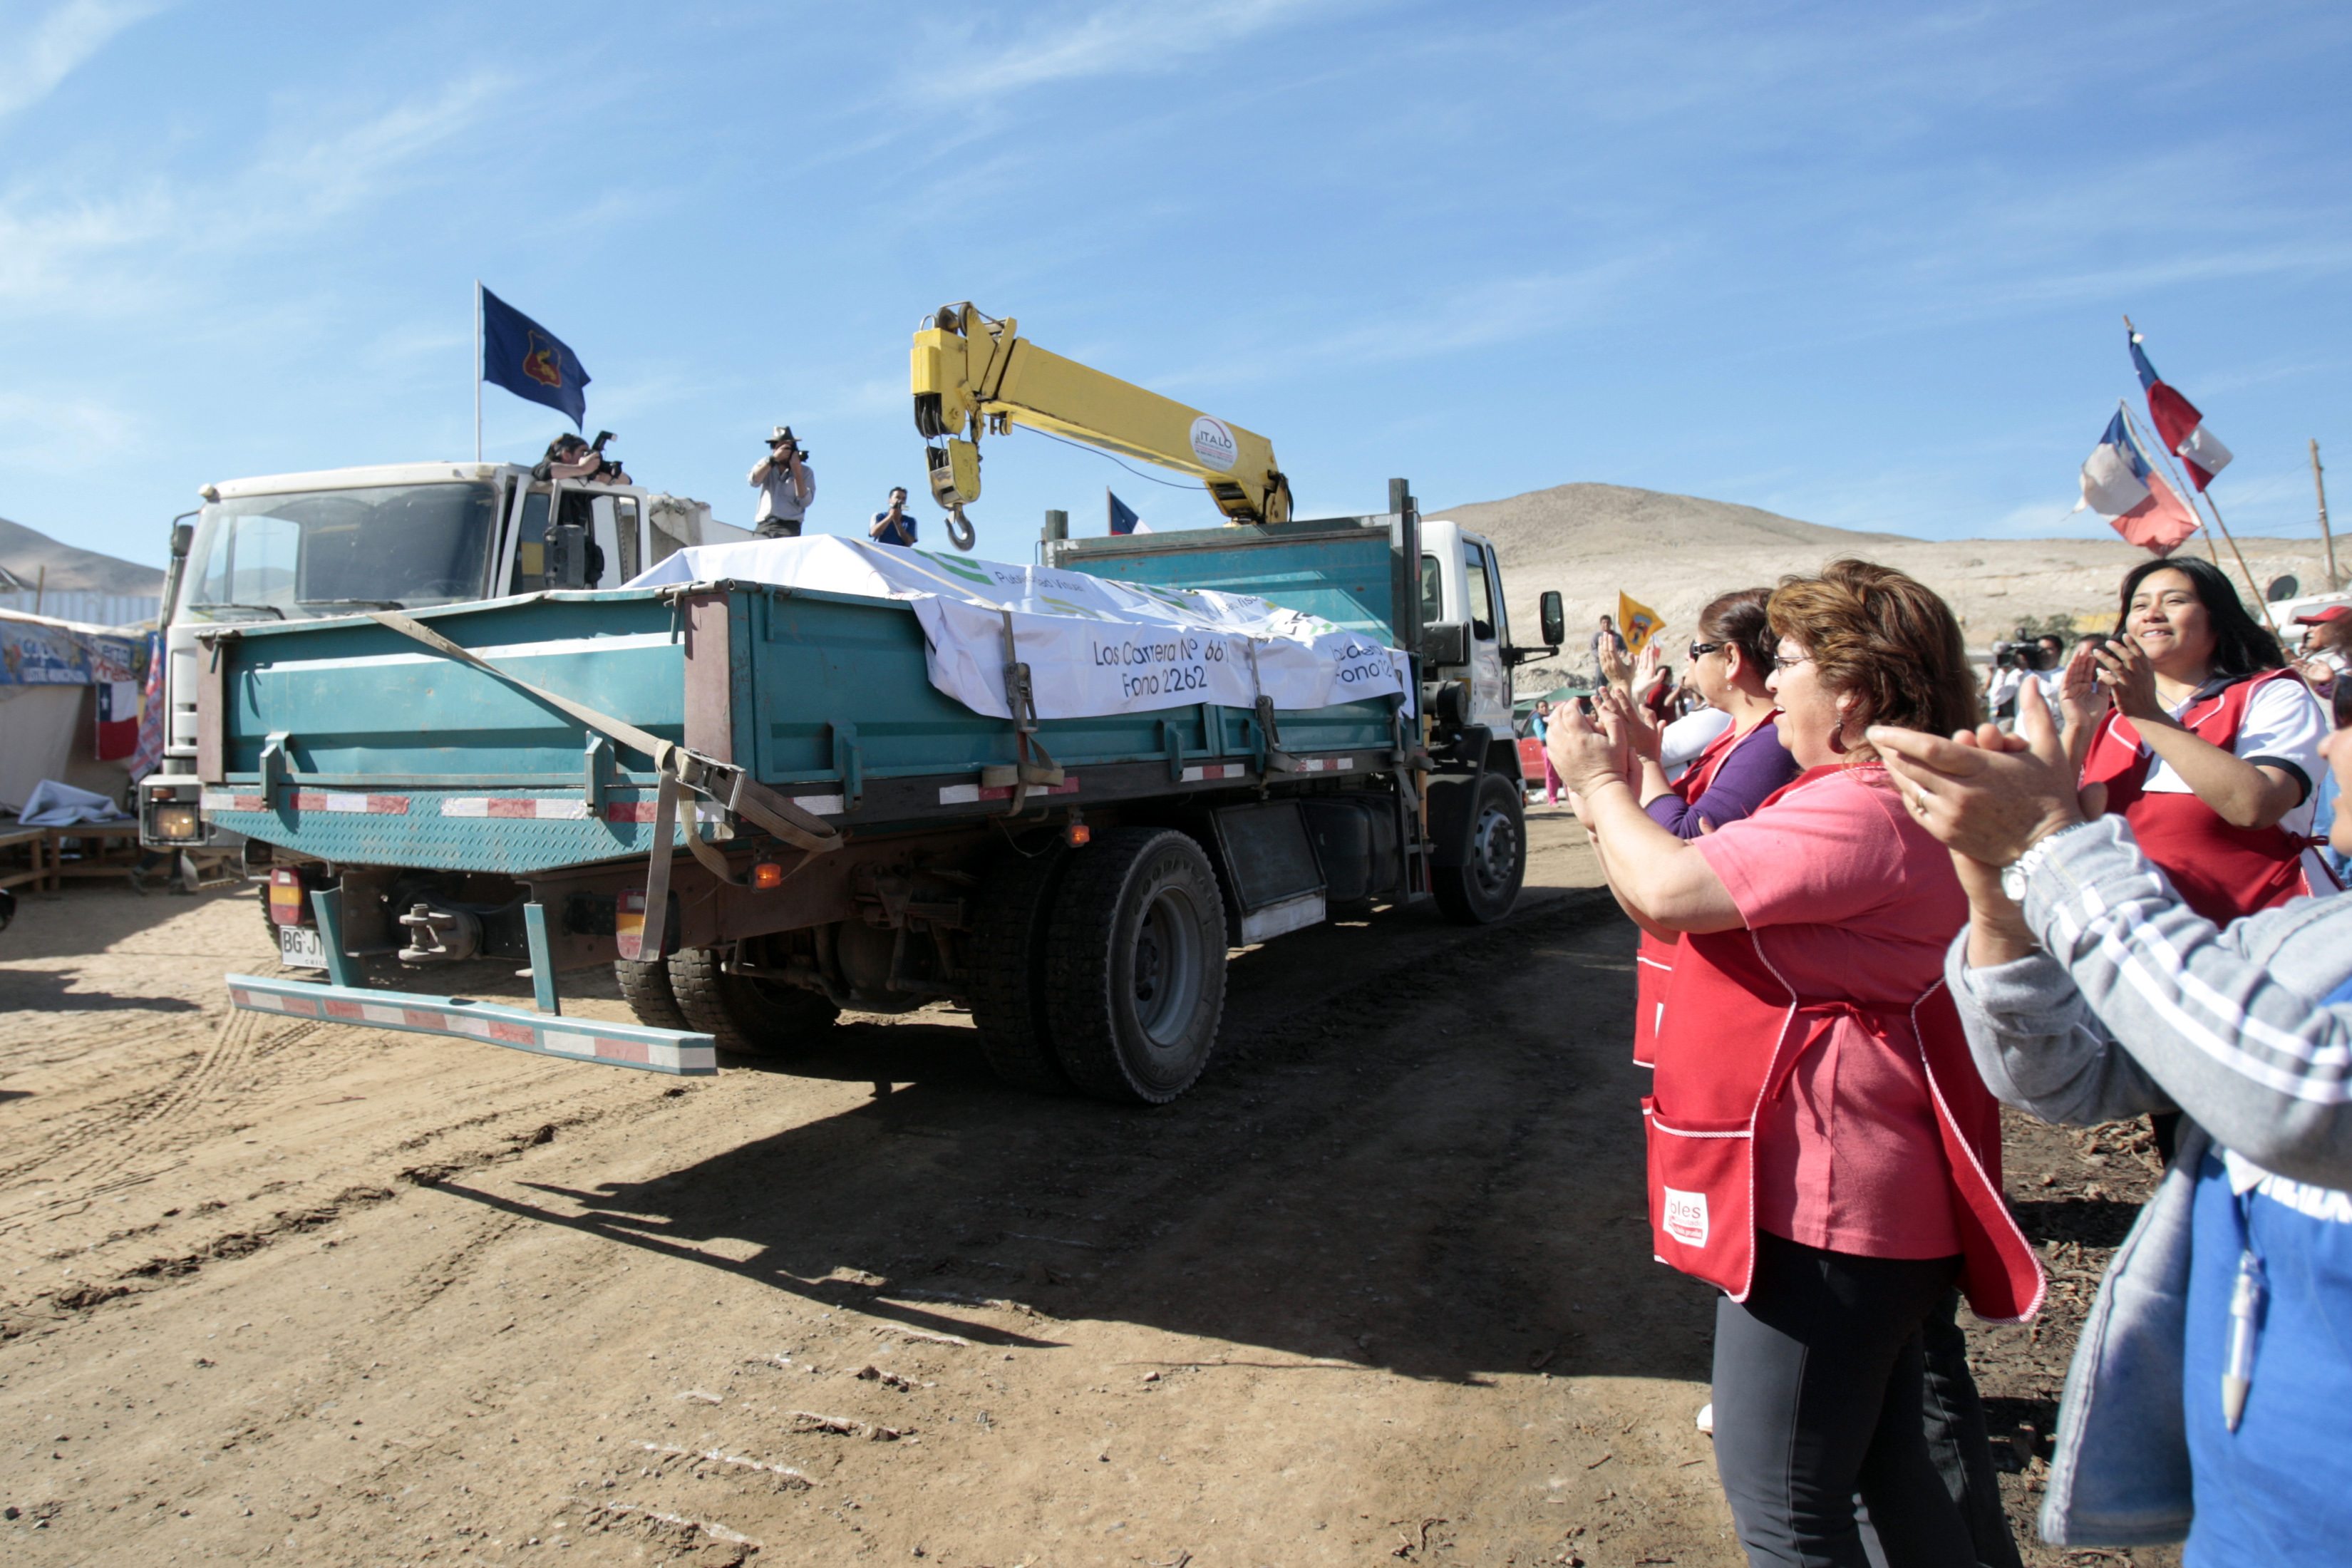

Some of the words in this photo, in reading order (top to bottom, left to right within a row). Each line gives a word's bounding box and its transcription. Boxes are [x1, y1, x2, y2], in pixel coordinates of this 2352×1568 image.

[1200, 430, 1232, 449] ITALO
[1093, 640, 1119, 666] Los
[1123, 641, 1176, 666] Carrera
[1122, 673, 1159, 698] Fono
[1162, 665, 1208, 693] 2262
[283, 931, 303, 954] BG
